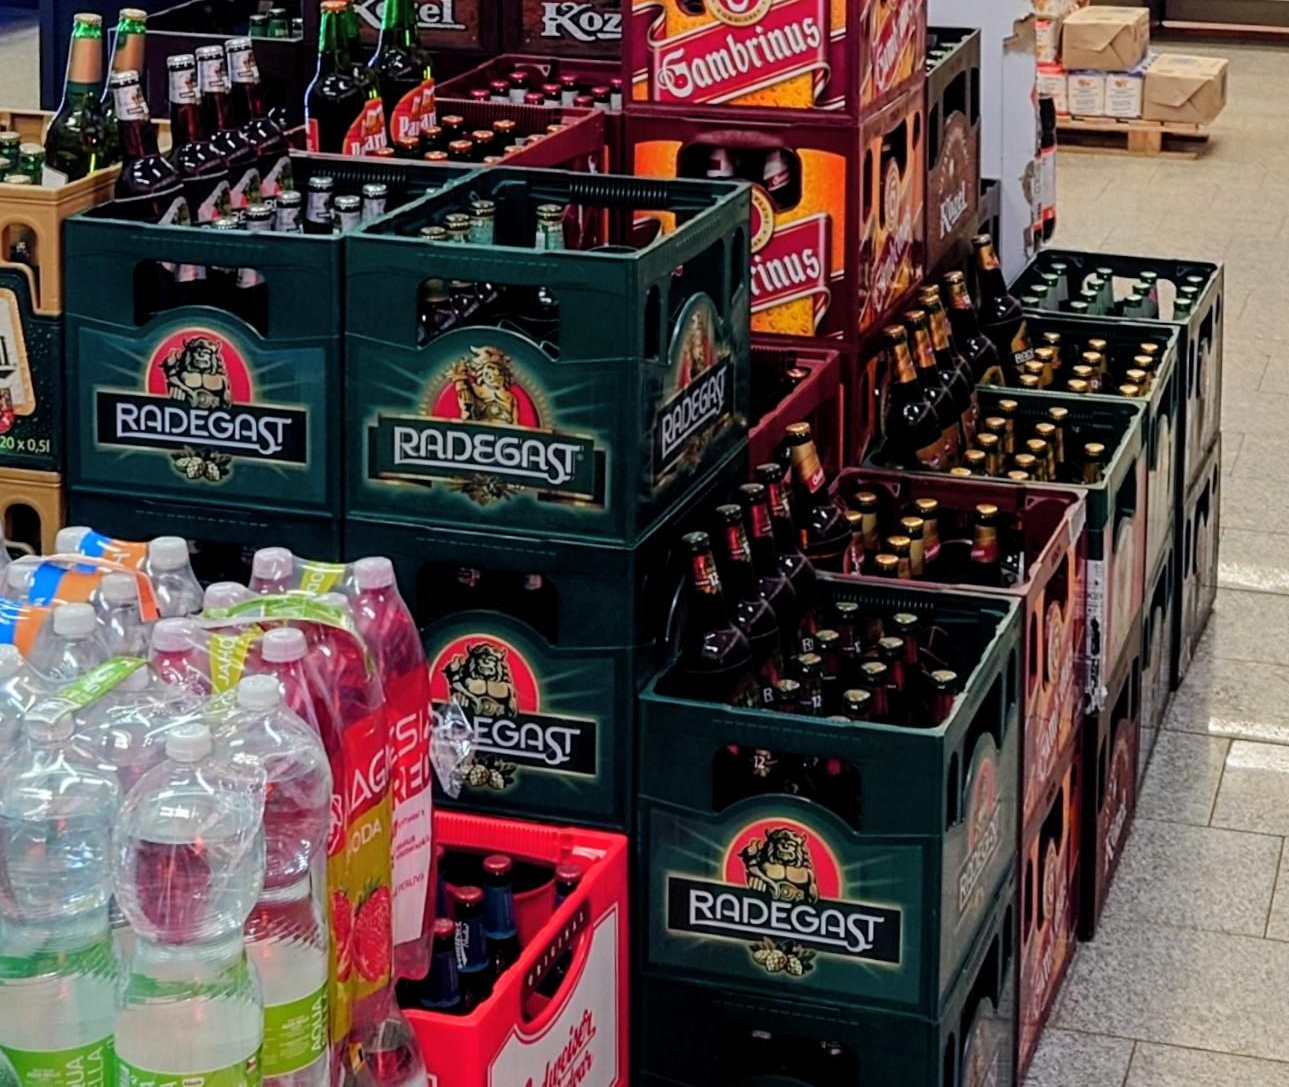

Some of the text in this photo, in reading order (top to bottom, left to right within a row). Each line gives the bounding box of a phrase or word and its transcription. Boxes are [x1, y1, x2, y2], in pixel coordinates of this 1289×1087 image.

[657, 16, 821, 98] Gambrinus
[116, 402, 292, 456] RADEGAST
[661, 363, 728, 458] RADEGAST
[0, 435, 15, 451] 20
[17, 439, 26, 451] x
[393, 424, 581, 486] RADEGAST
[688, 888, 886, 953] RADEGAST
